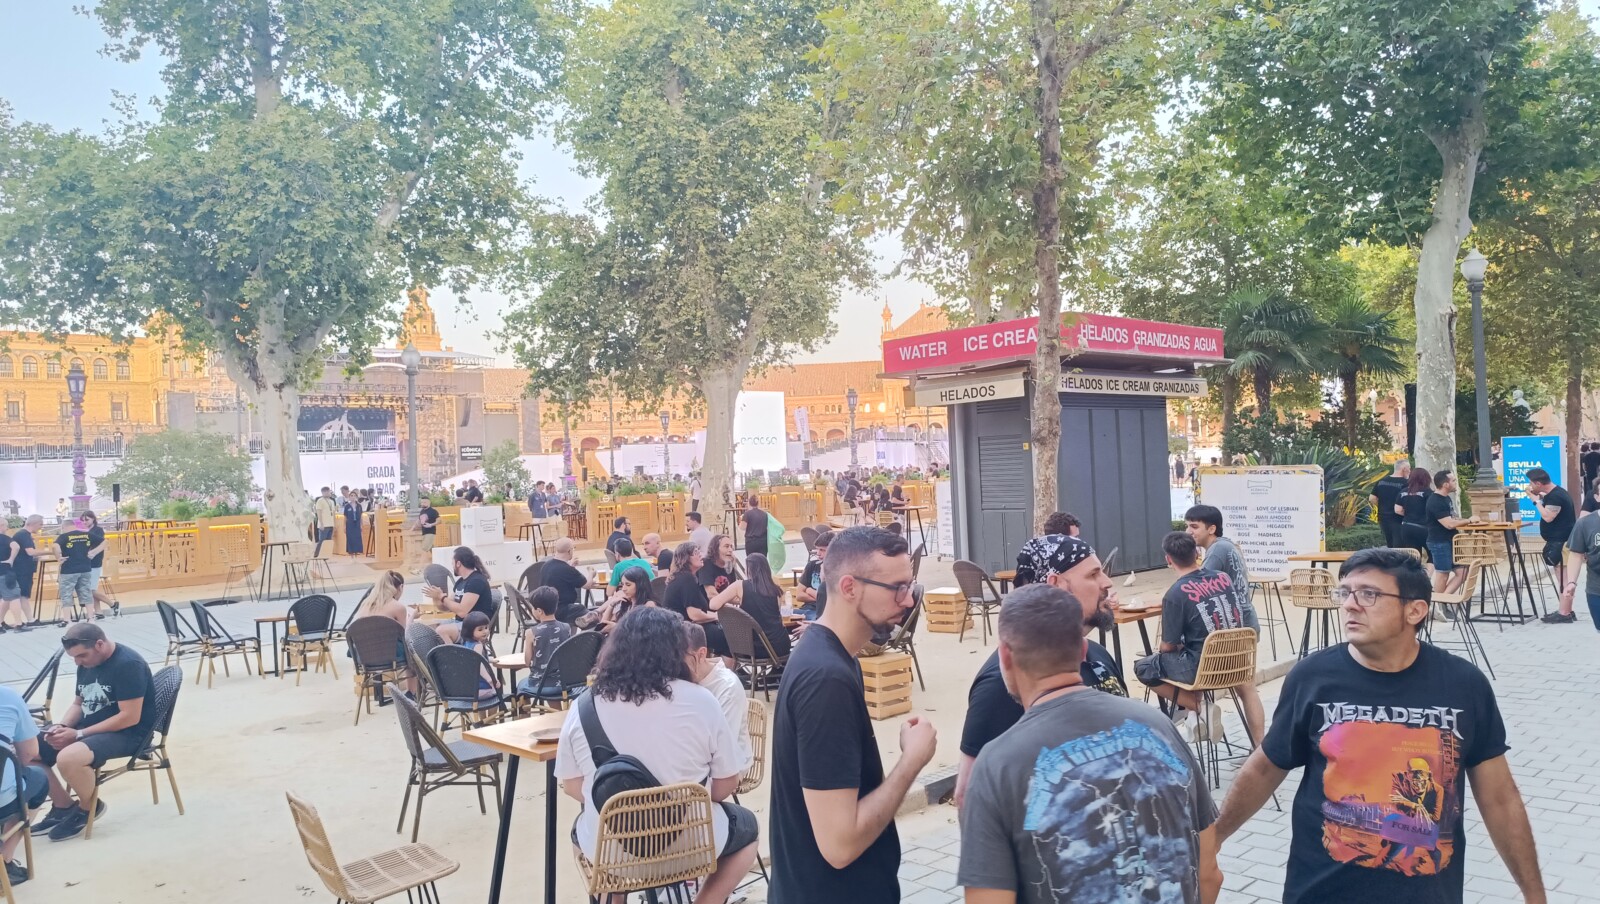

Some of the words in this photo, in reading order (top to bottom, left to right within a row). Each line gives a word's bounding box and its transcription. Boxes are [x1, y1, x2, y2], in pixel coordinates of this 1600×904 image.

[899, 341, 948, 362] WATER
[963, 333, 989, 353] ICE
[992, 328, 1038, 349] CREA
[1080, 323, 1129, 345] HELADOS
[1132, 329, 1191, 352] GRANIZADAS
[1194, 337, 1218, 353] AGUA
[940, 384, 996, 403] HELADOS
[1061, 376, 1103, 391] HELADOS
[1106, 379, 1120, 391] ICE
[1122, 380, 1151, 392] CREAM
[1152, 381, 1200, 394] GRANIZADAS
[367, 466, 396, 479] GRADA
[1508, 461, 1542, 469] SEVILLA
[1316, 701, 1465, 740] MEGADETH
[1392, 821, 1410, 832] FOR
